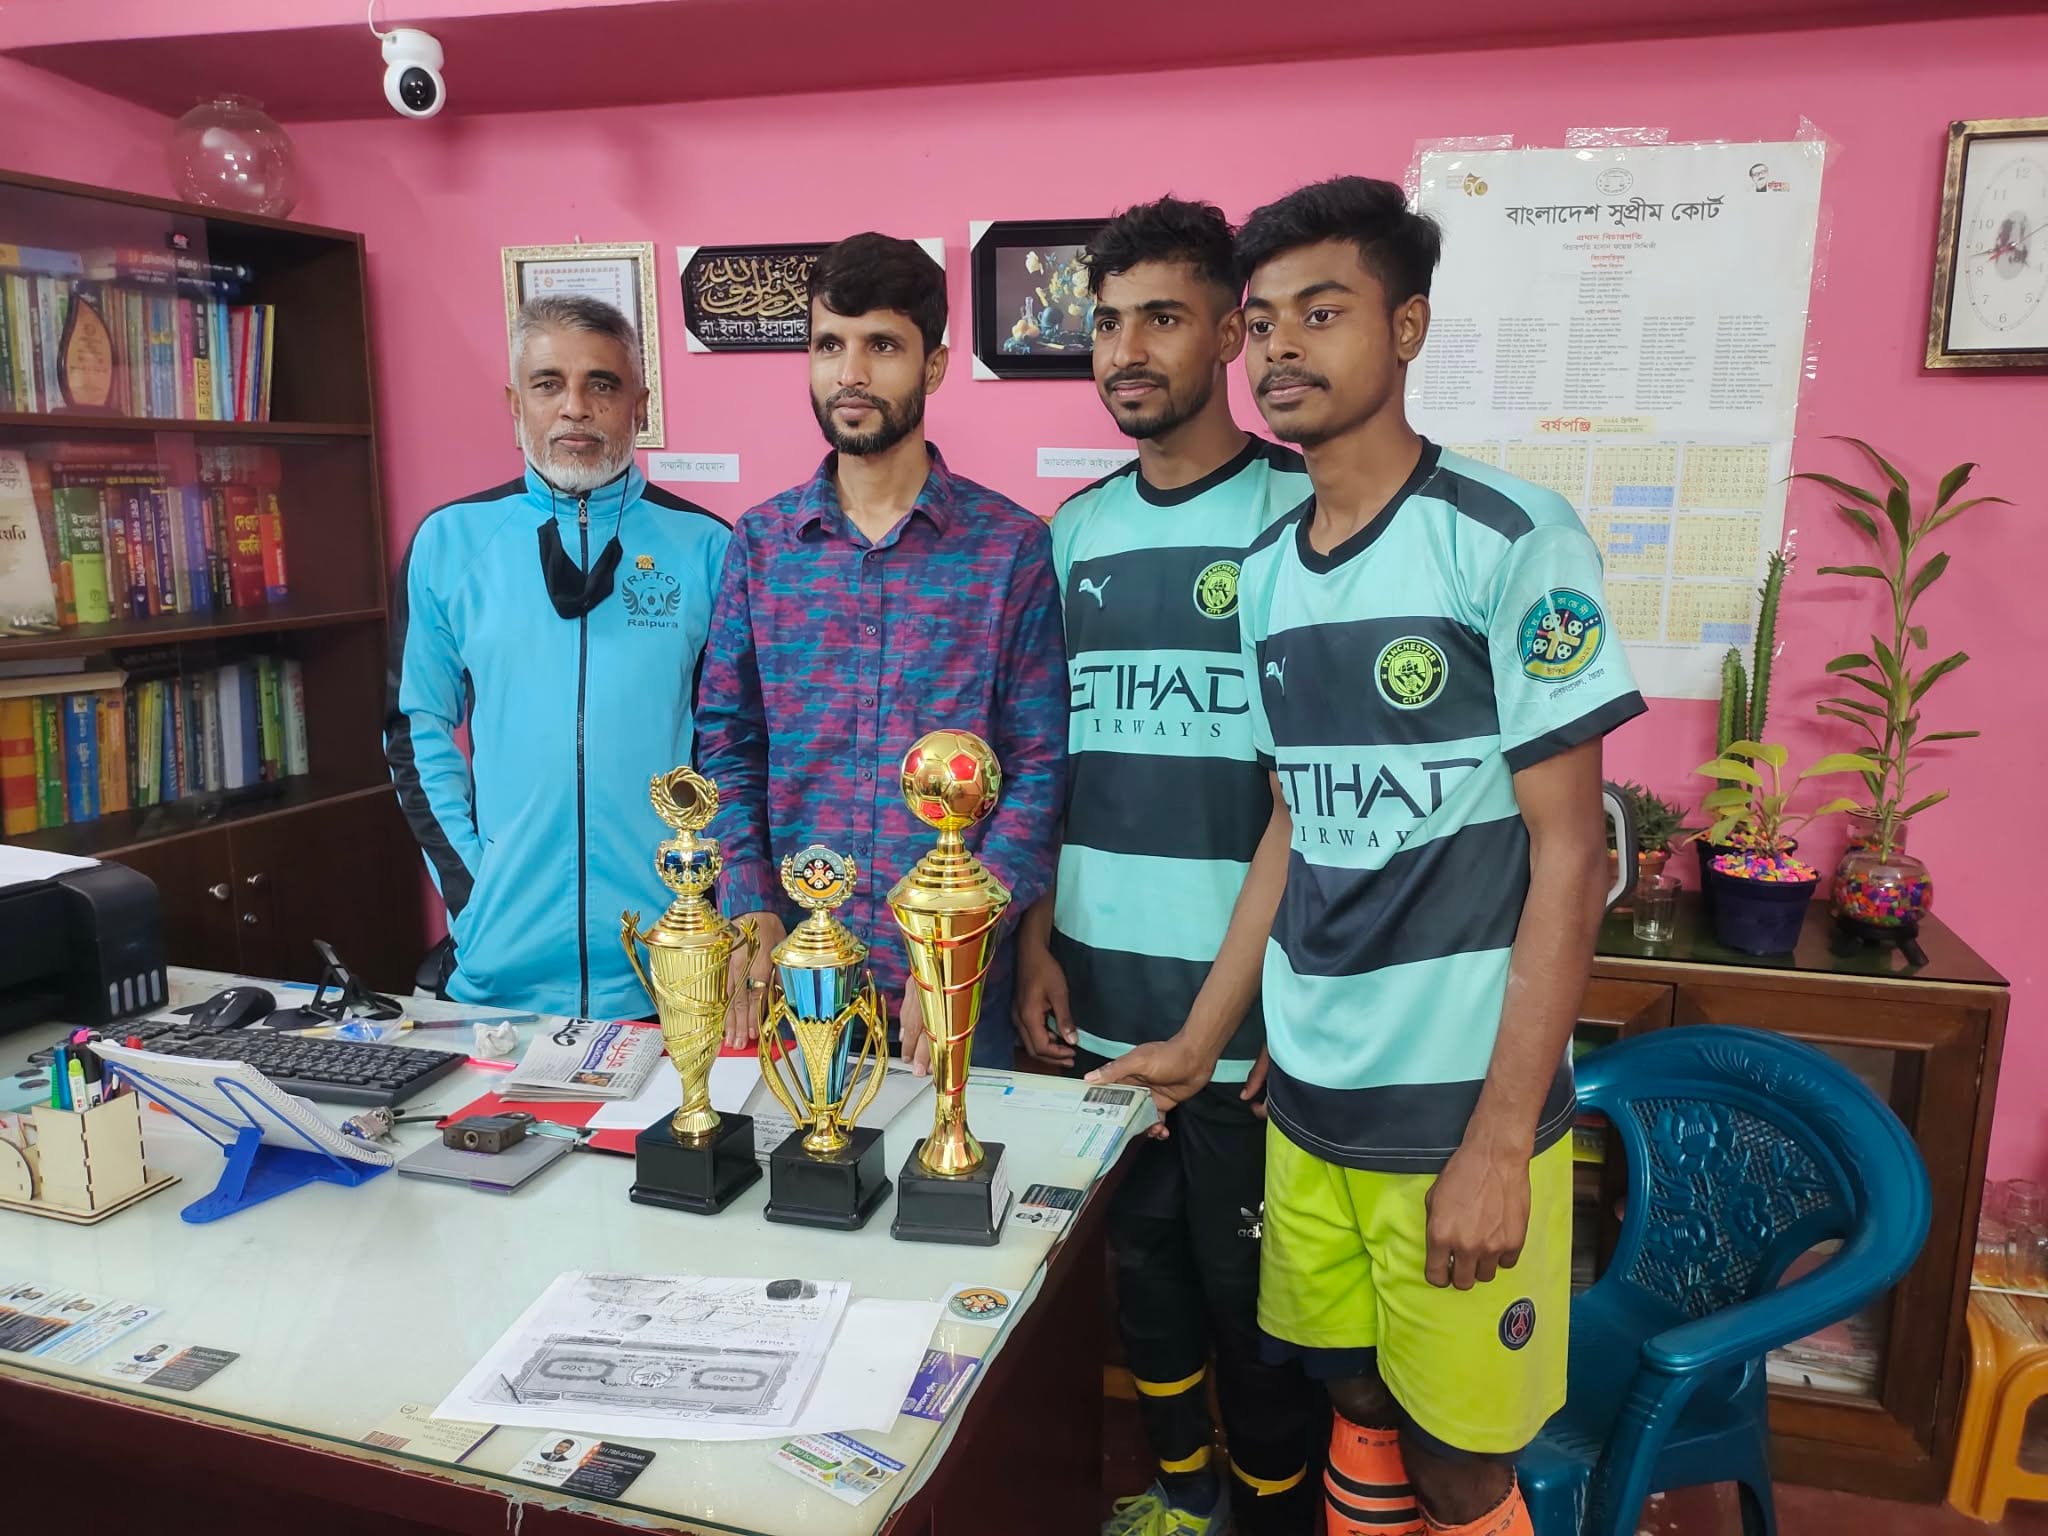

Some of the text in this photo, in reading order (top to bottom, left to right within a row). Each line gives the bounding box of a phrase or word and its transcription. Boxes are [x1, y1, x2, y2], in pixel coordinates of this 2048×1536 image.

[1505, 195, 1725, 227] বাংলাদেশ সুপ্রীম কোর্ট
[1382, 643, 1438, 668] MANCHESTER
[1070, 665, 1250, 714] ETIHAD
[1402, 694, 1424, 704] CITY
[1093, 718, 1222, 738] IRWAYS
